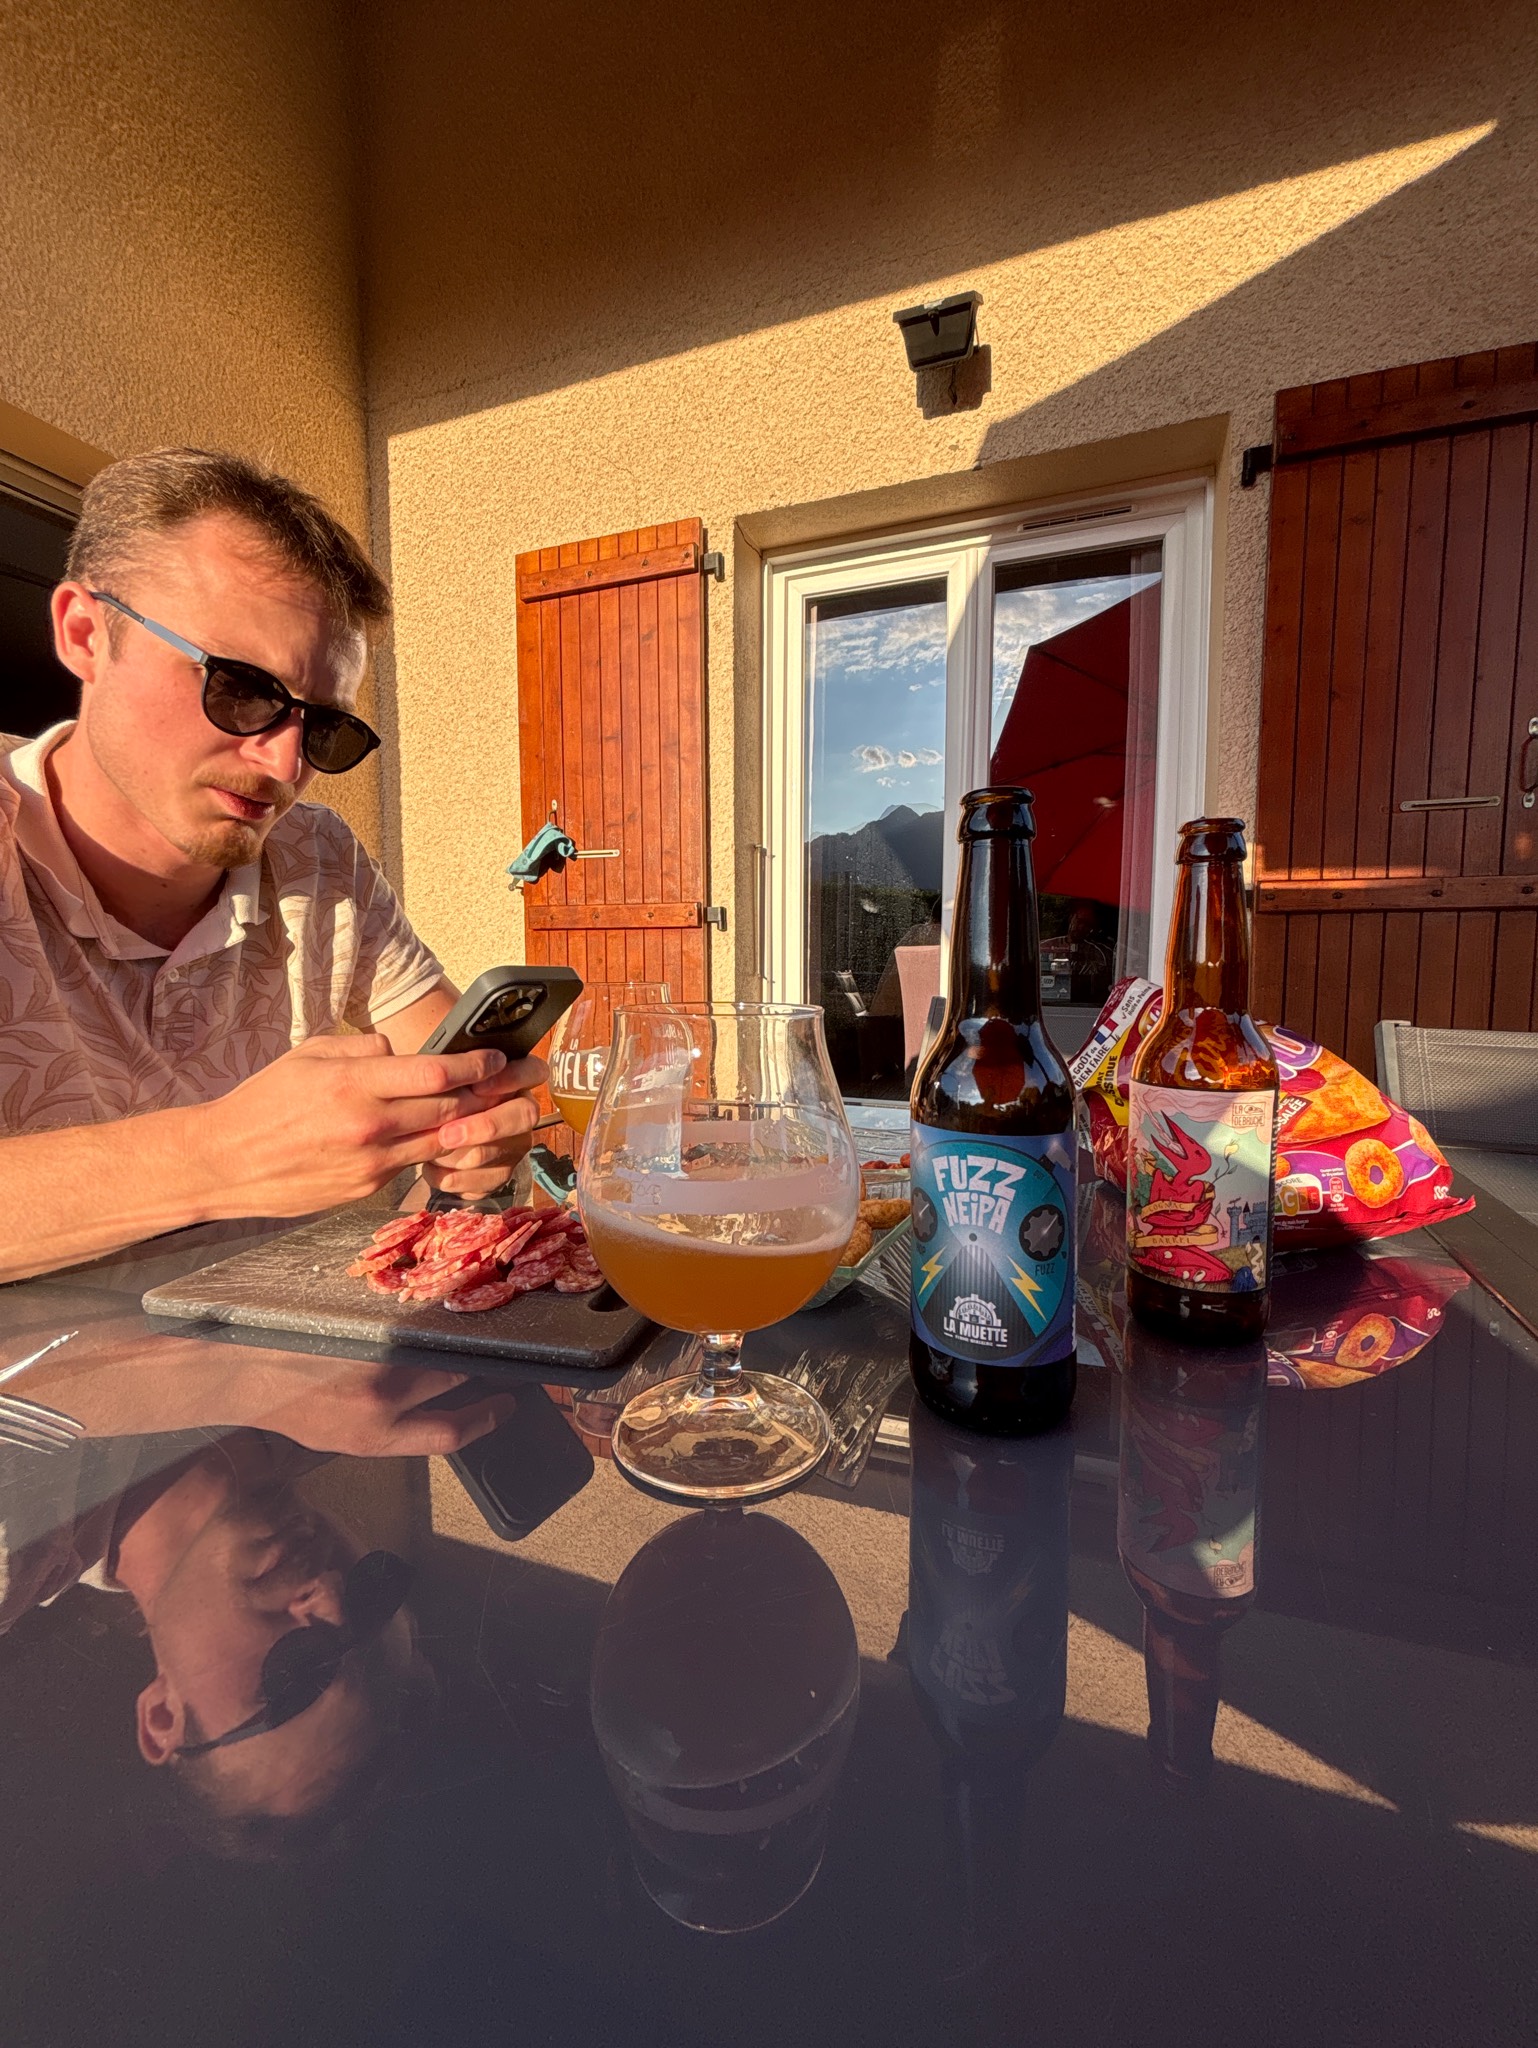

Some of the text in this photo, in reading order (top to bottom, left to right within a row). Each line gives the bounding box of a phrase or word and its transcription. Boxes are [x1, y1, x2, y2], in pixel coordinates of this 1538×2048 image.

[1122, 995, 1135, 1012] Sans
[569, 1038, 579, 1051] LA
[1073, 1053, 1092, 1075] GOÛT
[1074, 1044, 1111, 1087] BIEN FAIRE
[1234, 1104, 1244, 1114] LA
[931, 1154, 1028, 1202] FUZZ
[1148, 1202, 1185, 1212] COGNAC
[1034, 1262, 1056, 1276] FUZZ
[943, 1316, 1008, 1342] LA MUETTE
